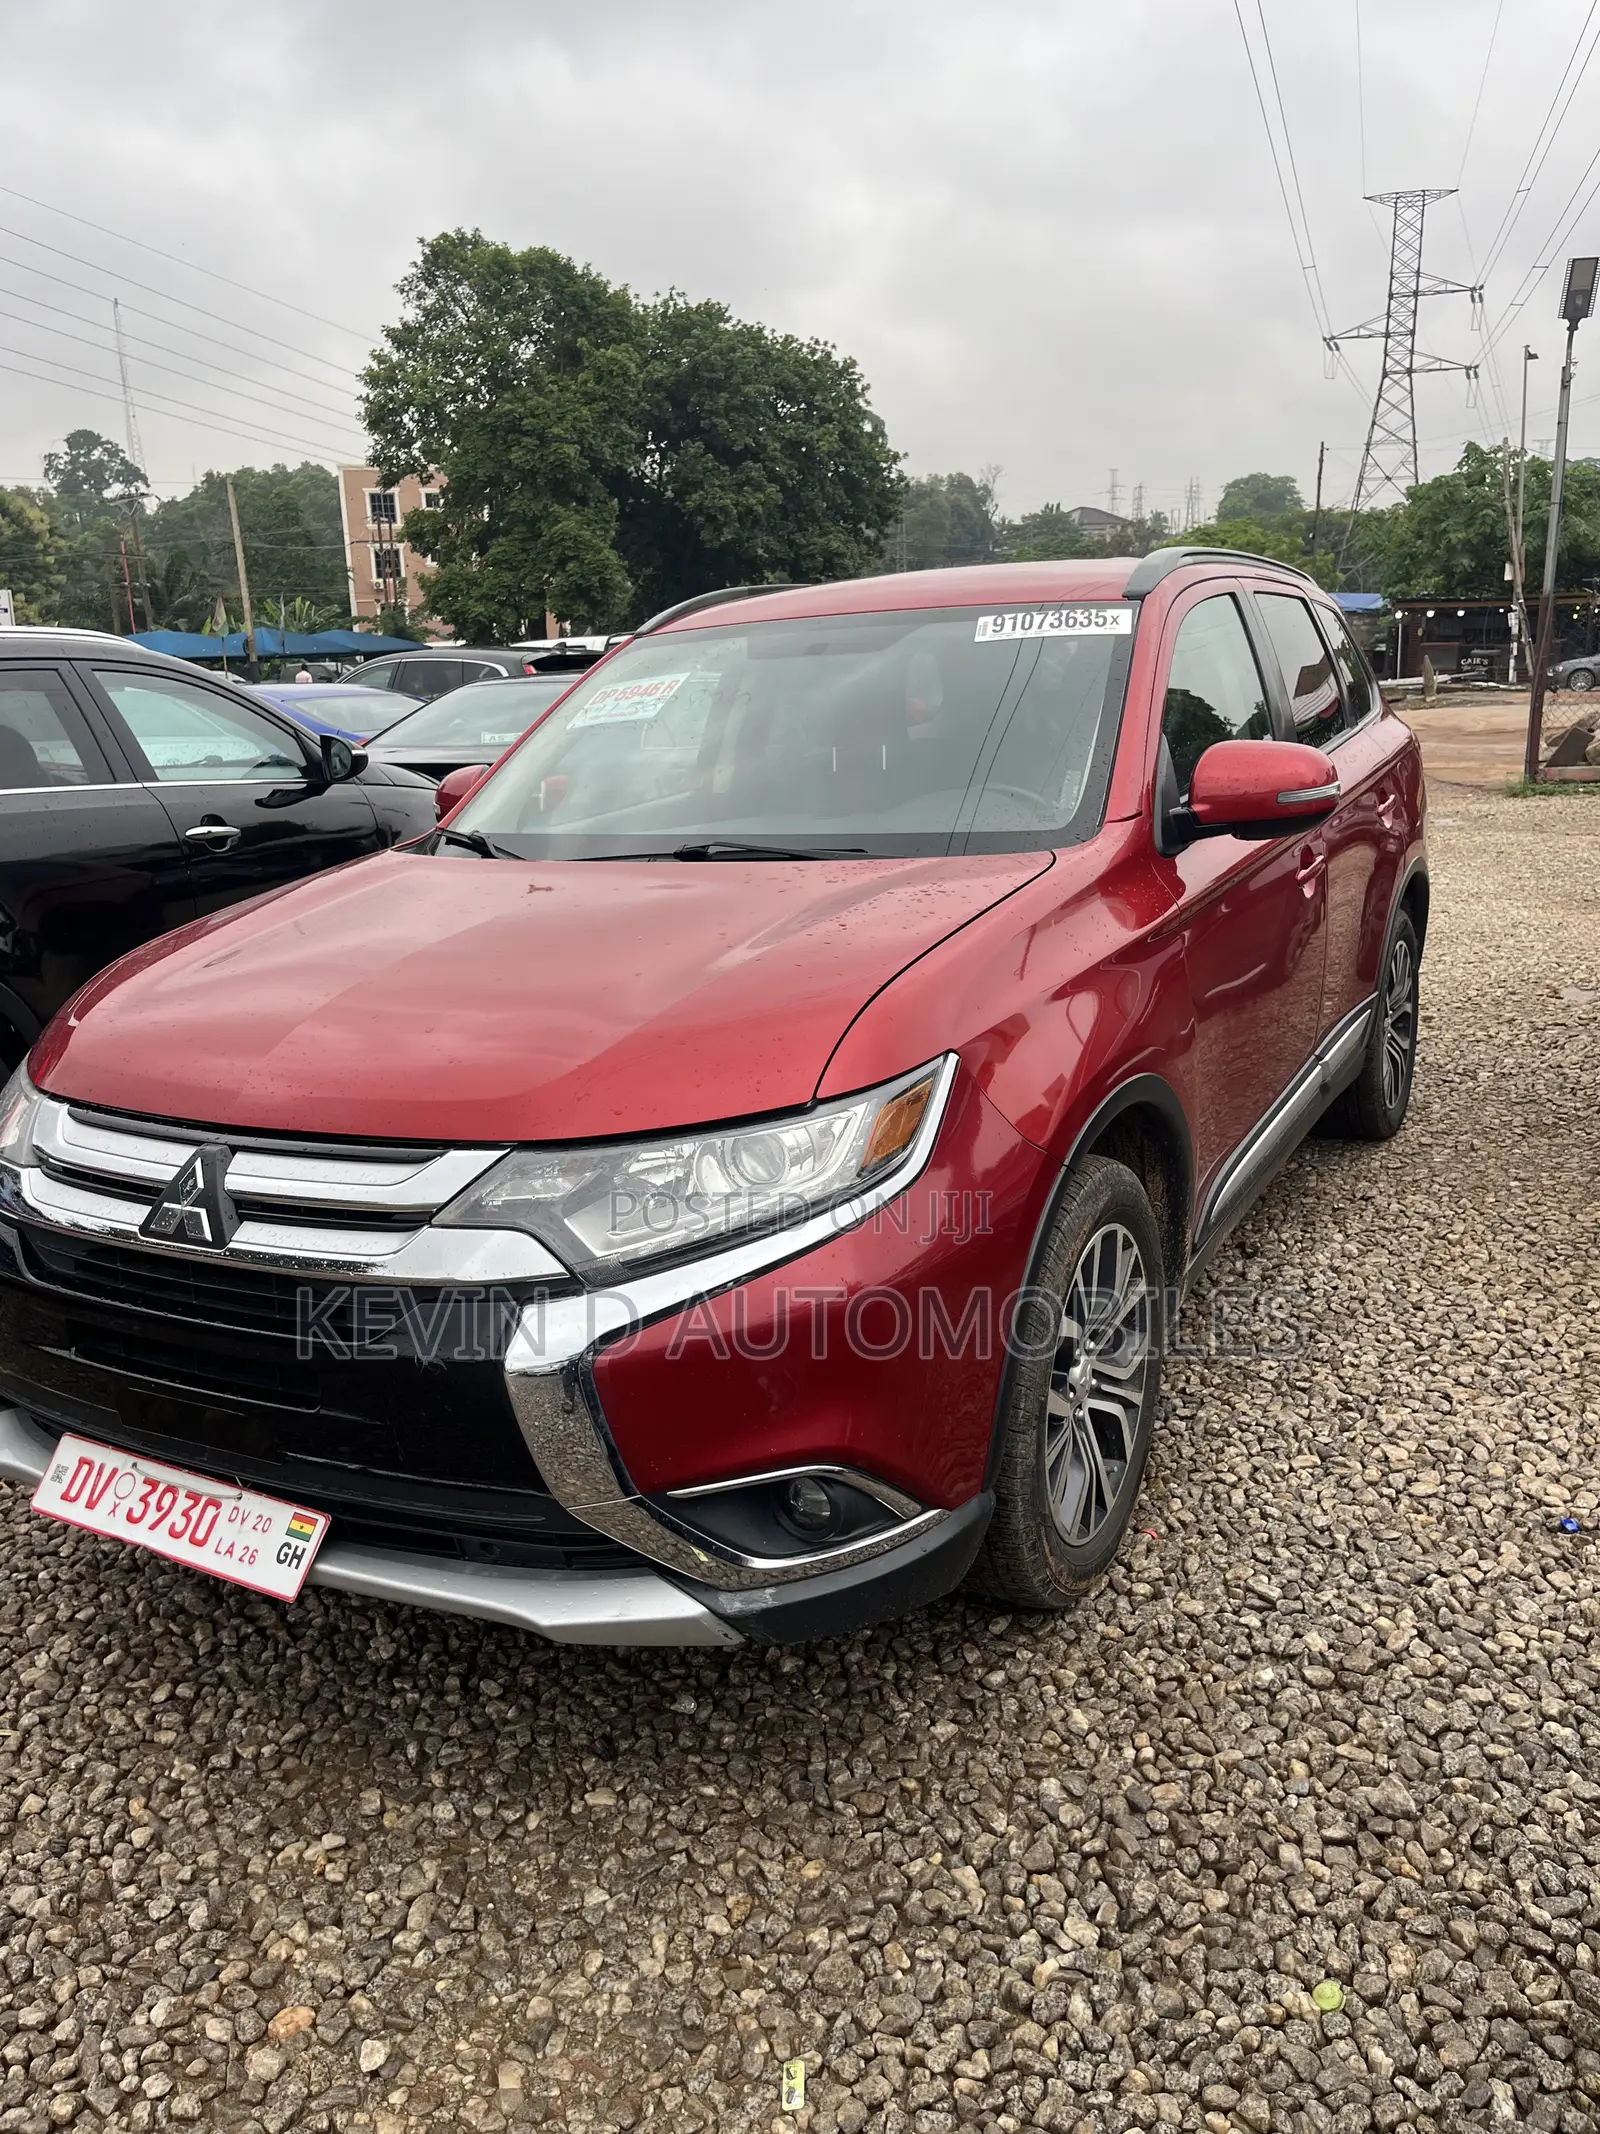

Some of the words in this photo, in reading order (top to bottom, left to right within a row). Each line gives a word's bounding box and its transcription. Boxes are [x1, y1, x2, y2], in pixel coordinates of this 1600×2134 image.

[60, 1456, 119, 1510] DV
[125, 1477, 223, 1548] 3930
[228, 1507, 251, 1526] DV
[252, 1514, 273, 1534] 20
[214, 1538, 234, 1559] LA
[239, 1545, 259, 1566] 26
[276, 1542, 307, 1570] GH
